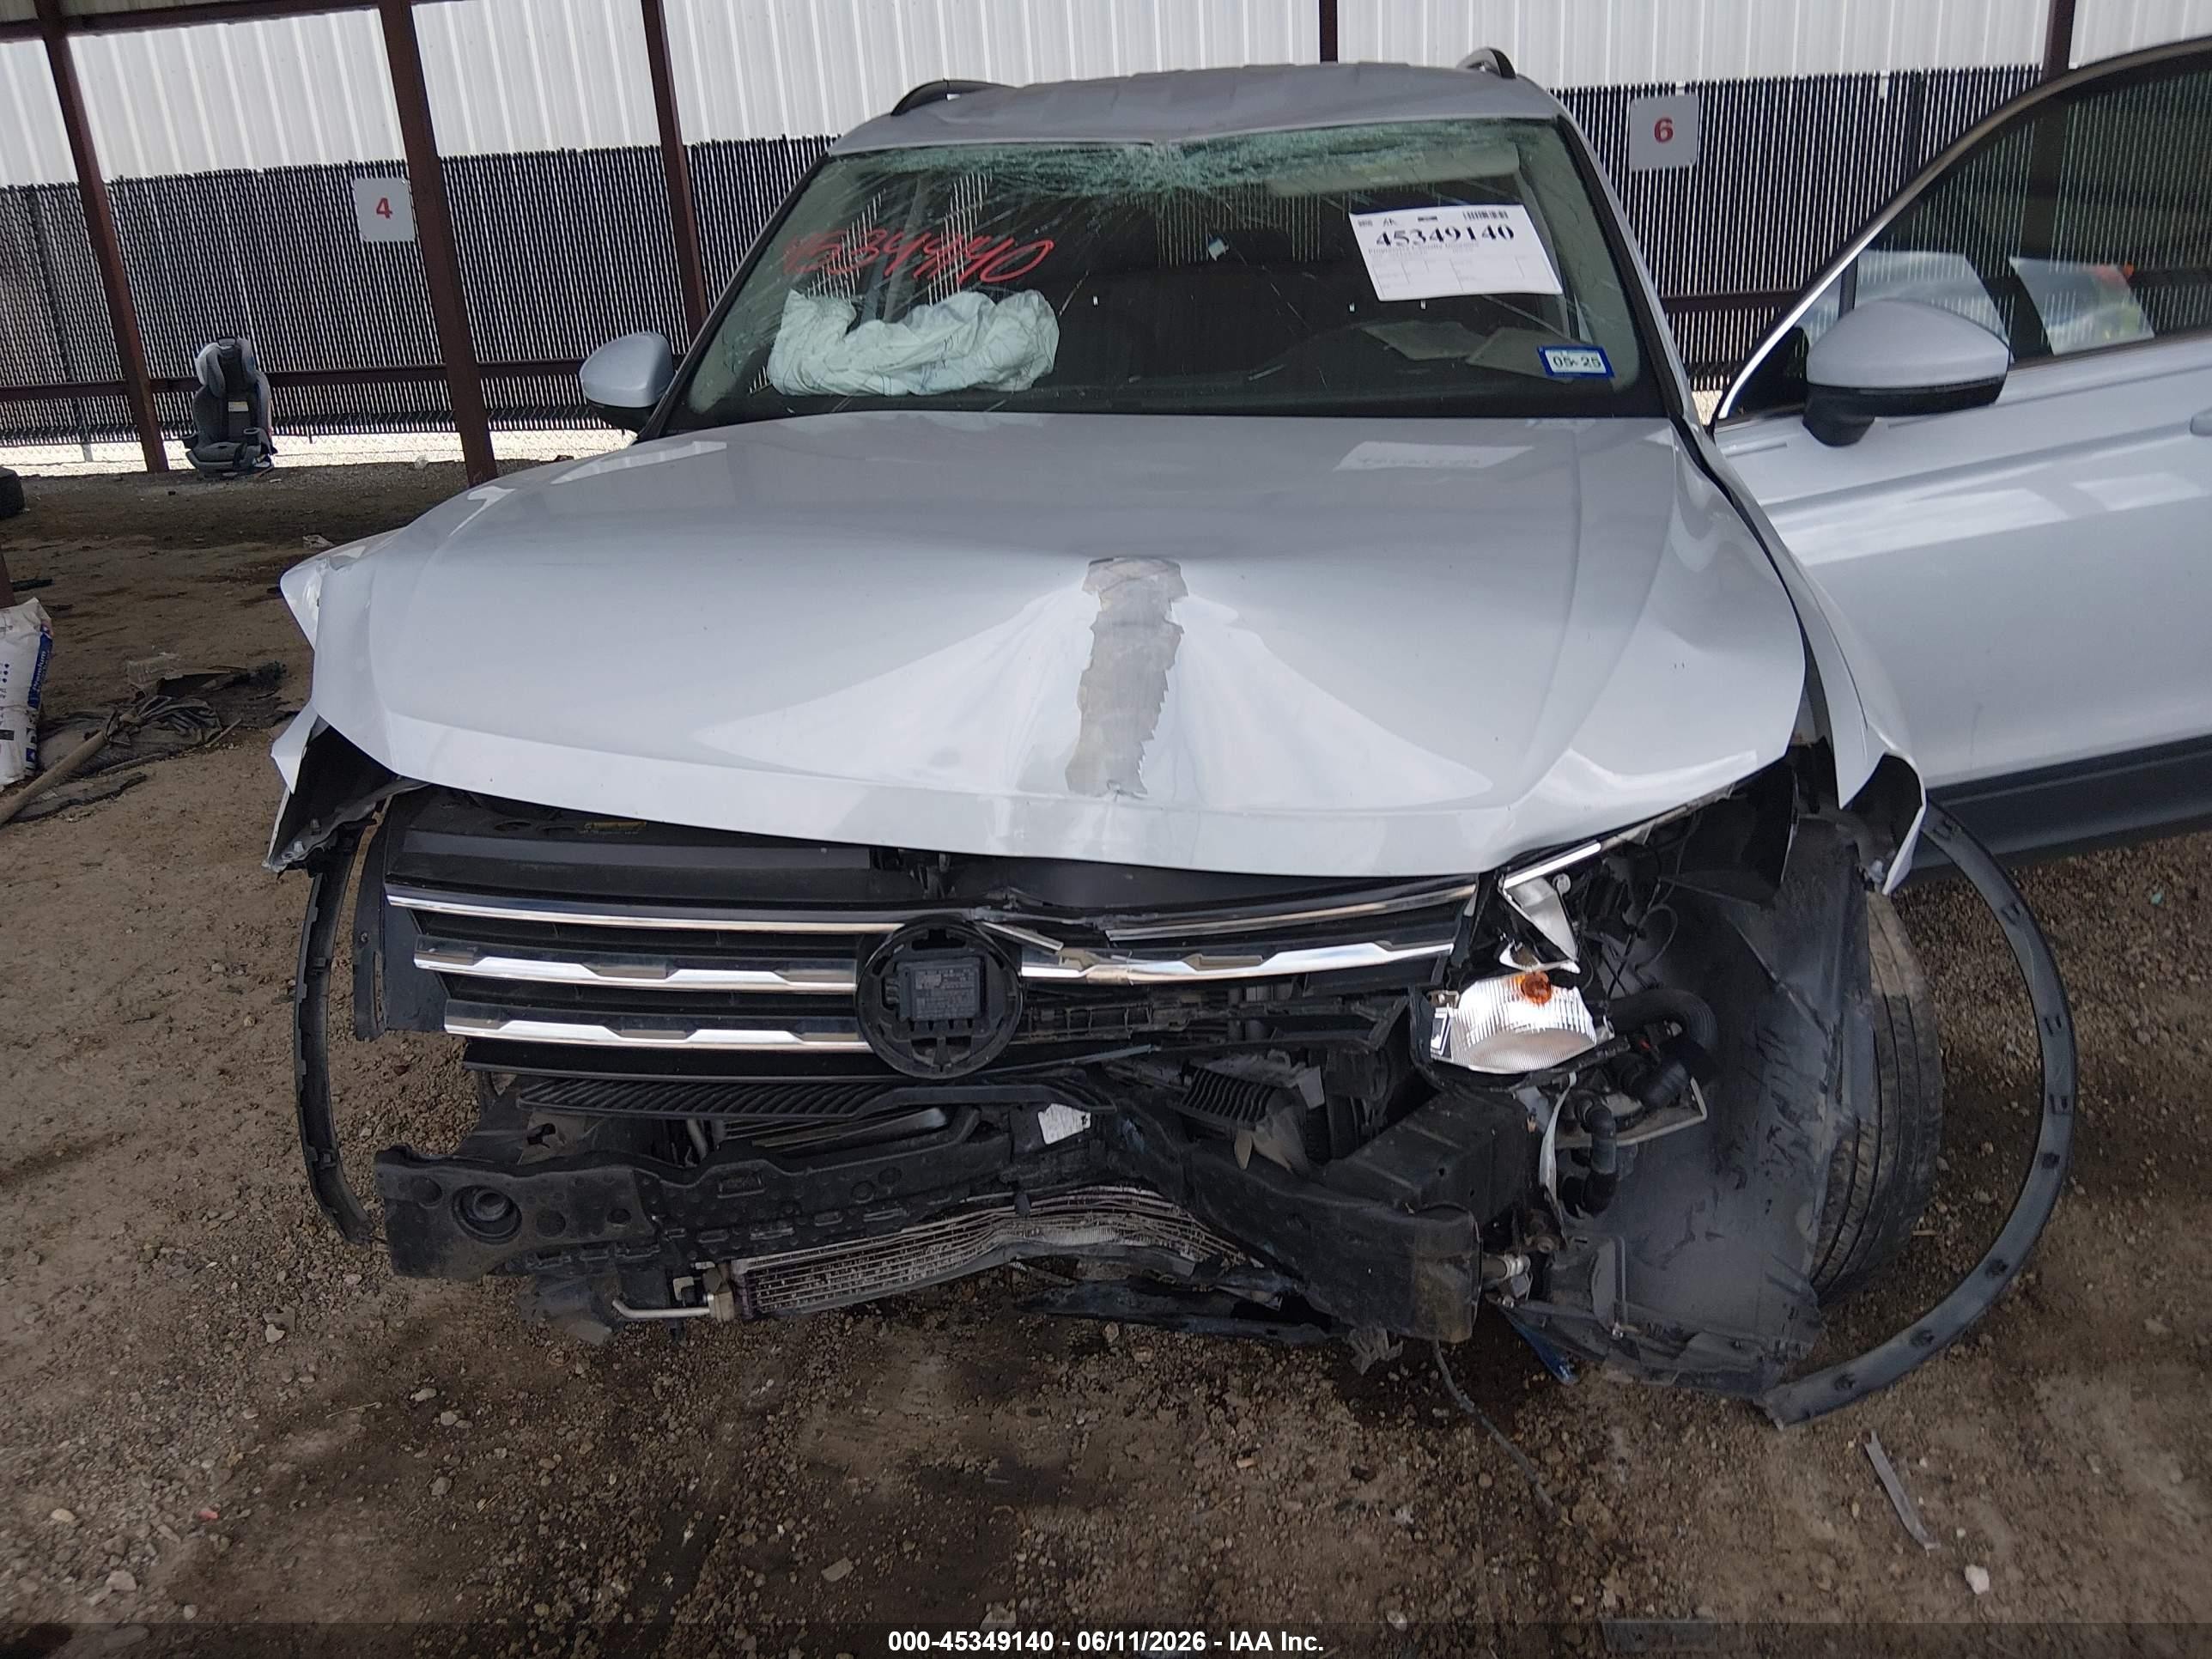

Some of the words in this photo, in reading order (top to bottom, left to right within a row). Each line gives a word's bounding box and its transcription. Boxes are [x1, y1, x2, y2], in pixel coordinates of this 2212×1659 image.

[1654, 117, 1674, 143] 6
[376, 197, 393, 220] 4
[1376, 223, 1516, 247] 45349140
